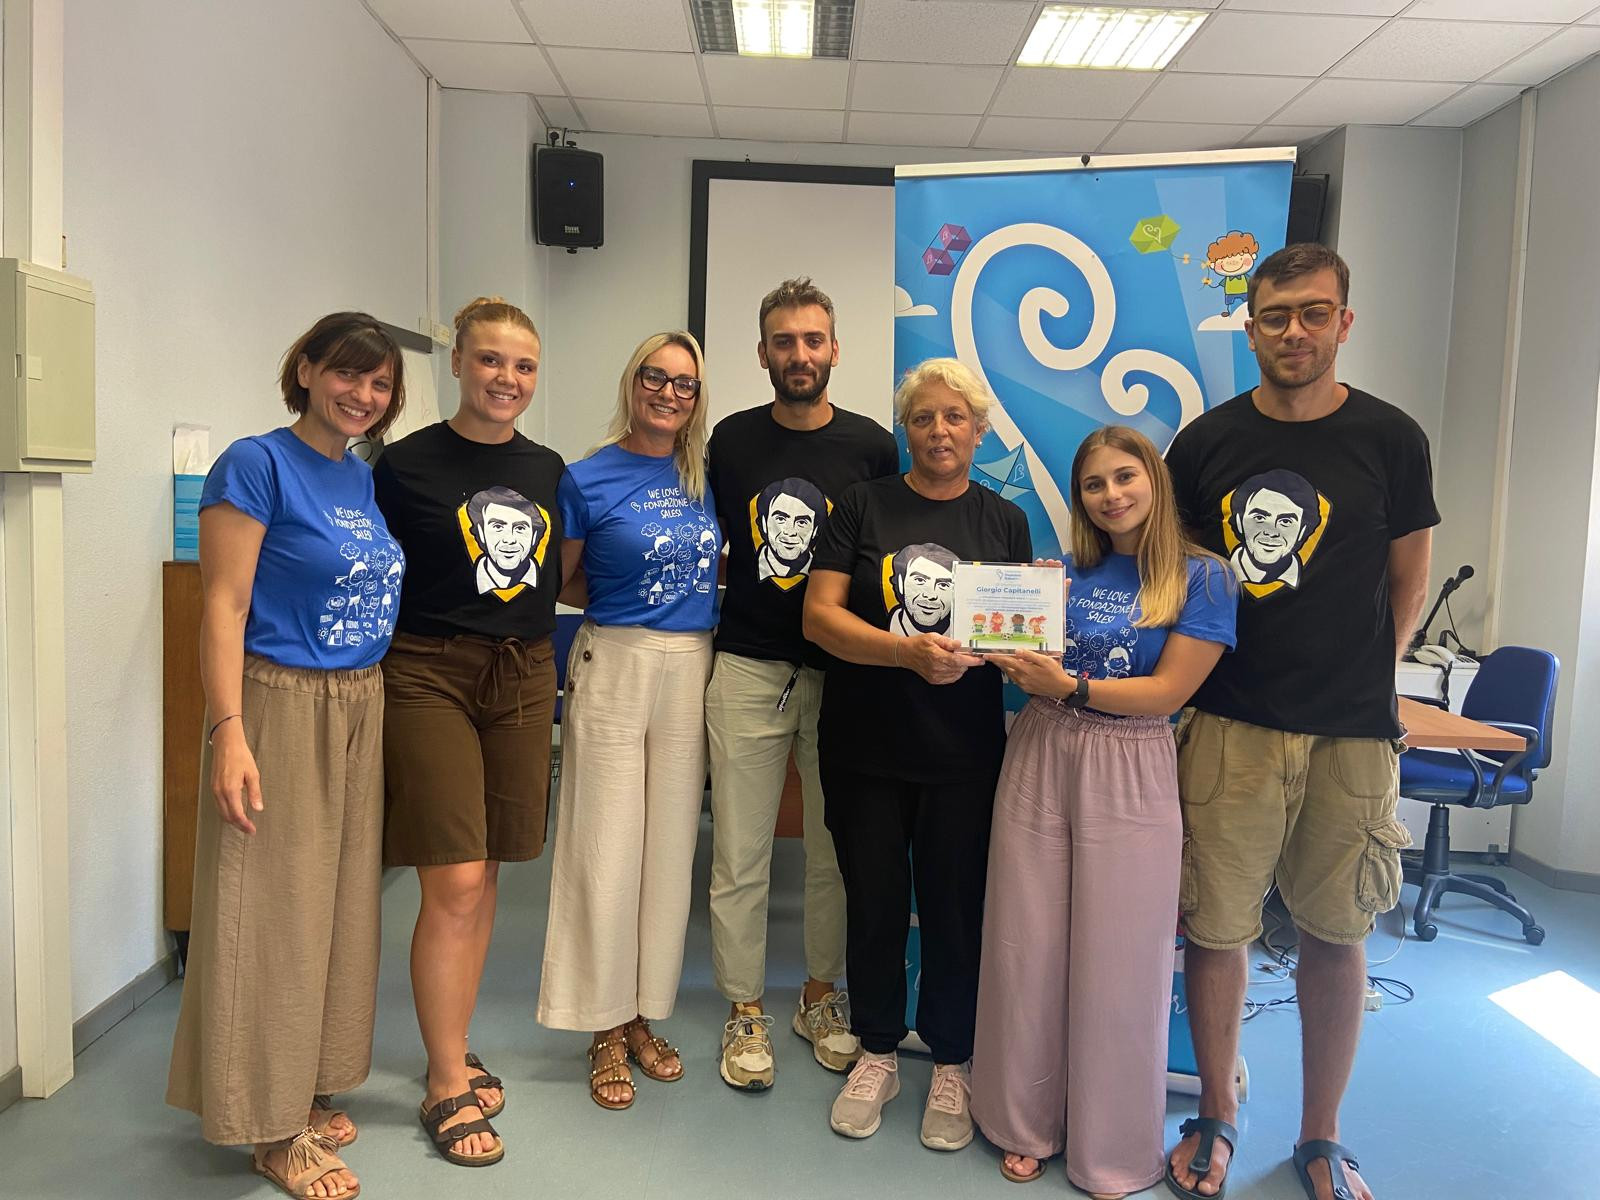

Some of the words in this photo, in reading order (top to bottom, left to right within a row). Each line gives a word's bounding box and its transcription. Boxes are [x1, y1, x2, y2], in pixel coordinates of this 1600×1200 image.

[648, 489, 660, 499] WE
[661, 487, 680, 498] LOVE
[643, 498, 689, 511] FONDAZIONE
[660, 509, 683, 519] SALESI
[976, 586, 1002, 594] Giorgio
[1003, 587, 1041, 595] Capitanelli
[1092, 587, 1108, 600] WE
[1107, 591, 1131, 604] LOVE
[1076, 598, 1134, 614] FONDAZIONE
[1086, 610, 1115, 624] SALESI
